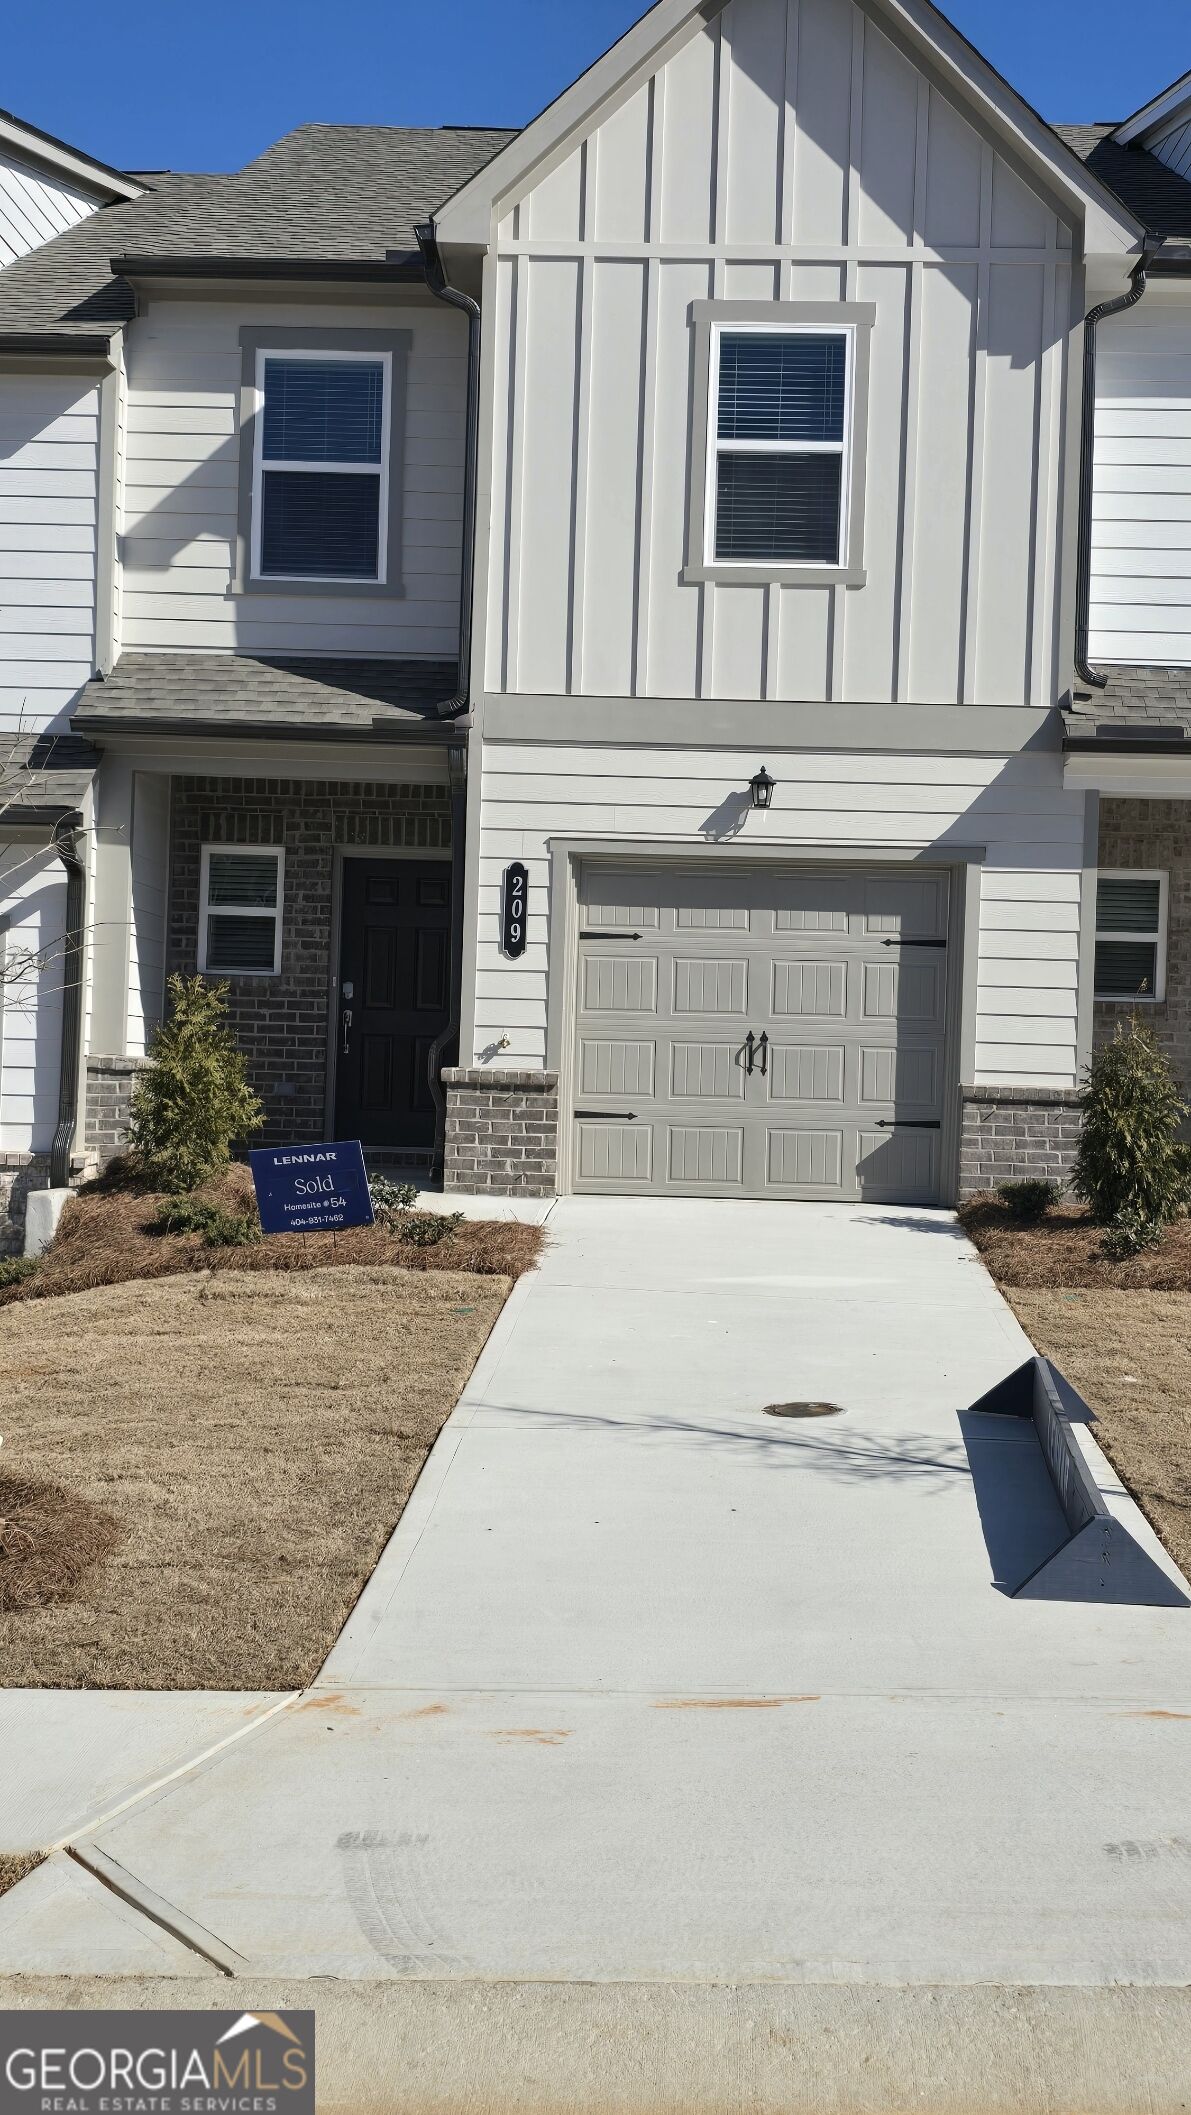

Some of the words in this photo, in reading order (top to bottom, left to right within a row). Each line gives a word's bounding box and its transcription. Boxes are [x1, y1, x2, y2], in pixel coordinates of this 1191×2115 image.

[510, 876, 523, 942] 209
[273, 1152, 337, 1165] LENNAR
[294, 1174, 334, 1195] Sold
[284, 1202, 321, 1212] Homesite
